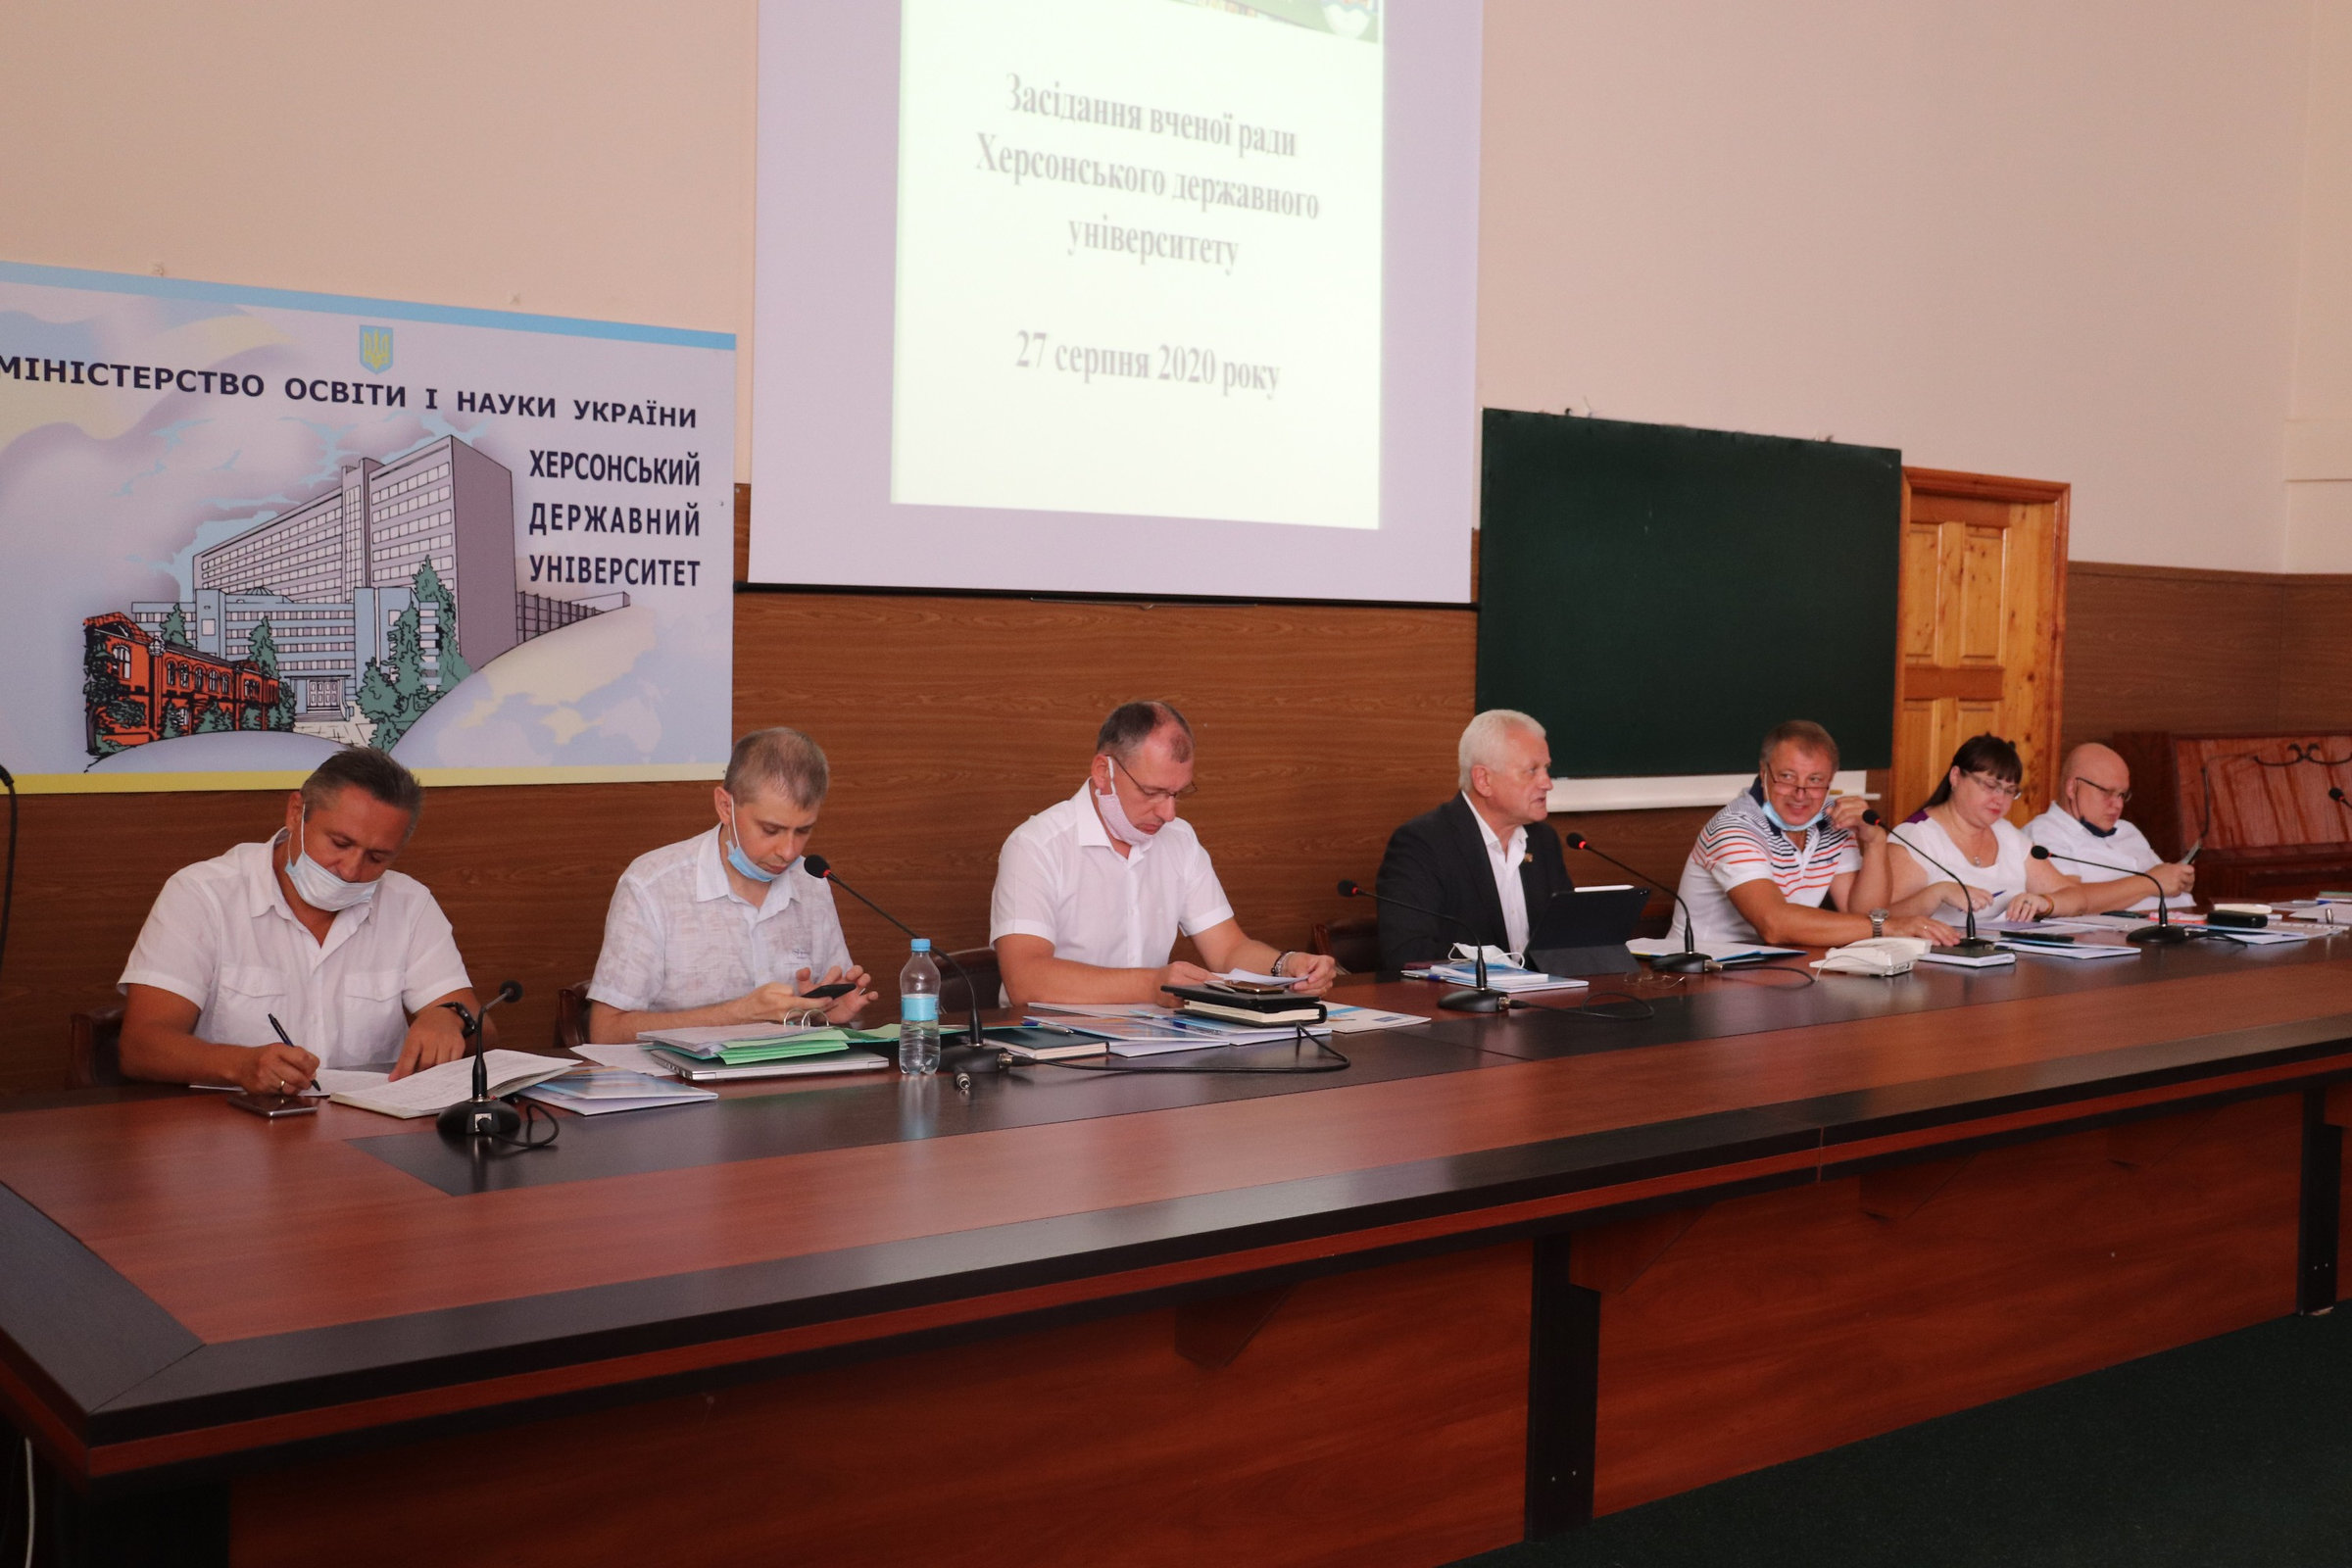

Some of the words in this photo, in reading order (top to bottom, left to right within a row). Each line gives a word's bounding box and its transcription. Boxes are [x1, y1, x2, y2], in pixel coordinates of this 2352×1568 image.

[1005, 73, 1143, 130] Засідання
[1149, 108, 1234, 146] вченої
[1238, 122, 1298, 158] ради
[975, 131, 1166, 196] Херсонського
[1172, 172, 1320, 220] державного
[1066, 214, 1240, 276] університету
[0, 355, 265, 397] МІНІСТЕРСТВО
[284, 377, 407, 409] ОСВІТИ
[425, 388, 438, 410] І
[457, 390, 557, 418] НАУКИ
[573, 399, 697, 428] УКРАЇНИ
[1015, 329, 1048, 369] 27
[1054, 344, 1151, 384] серпня
[1157, 344, 1217, 384] 2020
[1223, 360, 1281, 401] року
[529, 450, 701, 486] ХЕРСОНСЬКИЙ
[529, 502, 701, 536] ДЕРЖАВНИЙ
[529, 555, 701, 587] УНІВЕРСИТЕТ
